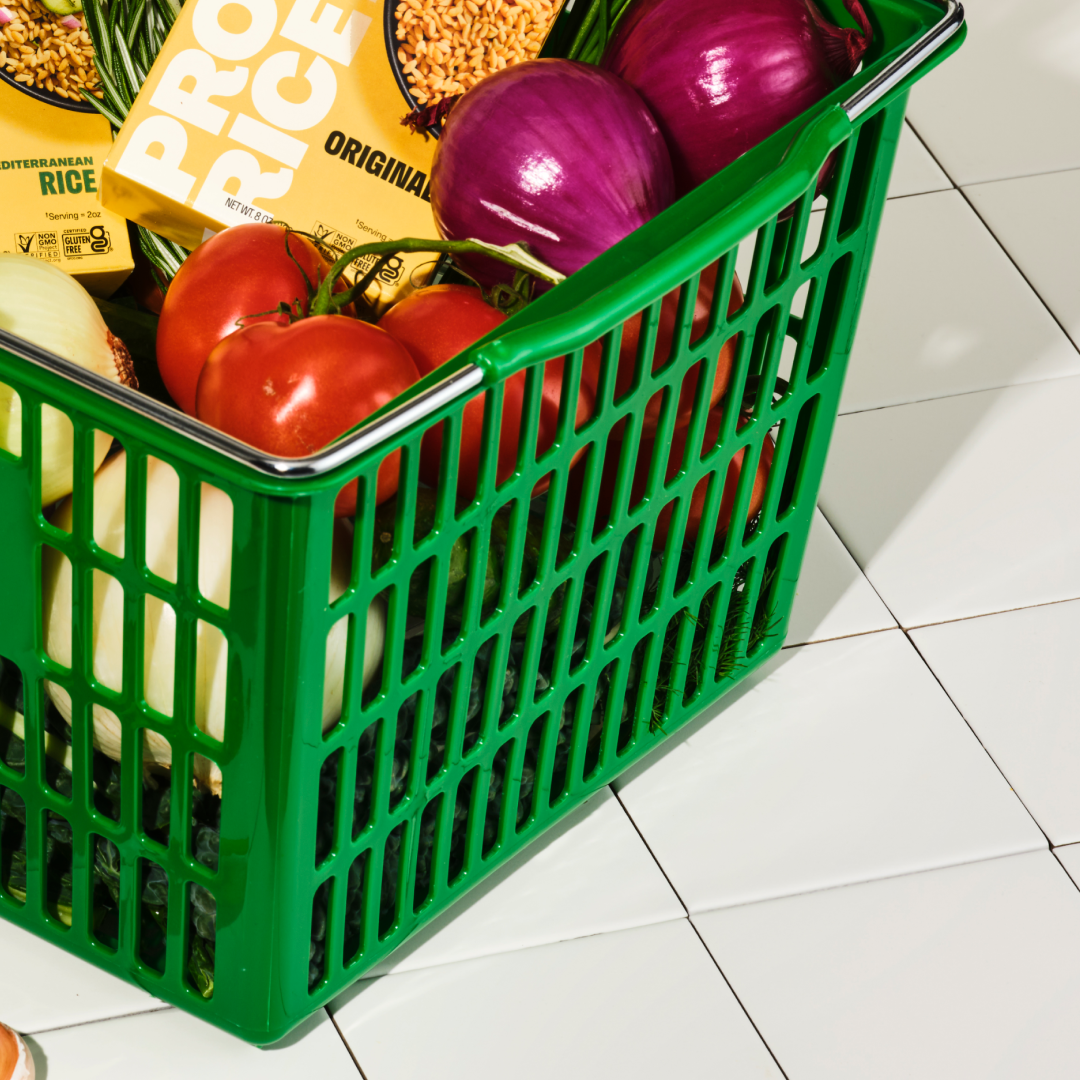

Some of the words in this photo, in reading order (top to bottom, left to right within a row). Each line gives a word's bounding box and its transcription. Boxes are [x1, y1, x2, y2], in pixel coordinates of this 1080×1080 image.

[38, 169, 98, 196] RICE
[87, 211, 102, 219] 2oz
[224, 197, 241, 211] NET
[253, 211, 262, 221] 8
[64, 235, 91, 245] GLUTEN
[333, 239, 351, 251] GMO
[336, 233, 354, 246] NON
[65, 245, 82, 254] FREE
[354, 258, 371, 272] FREE
